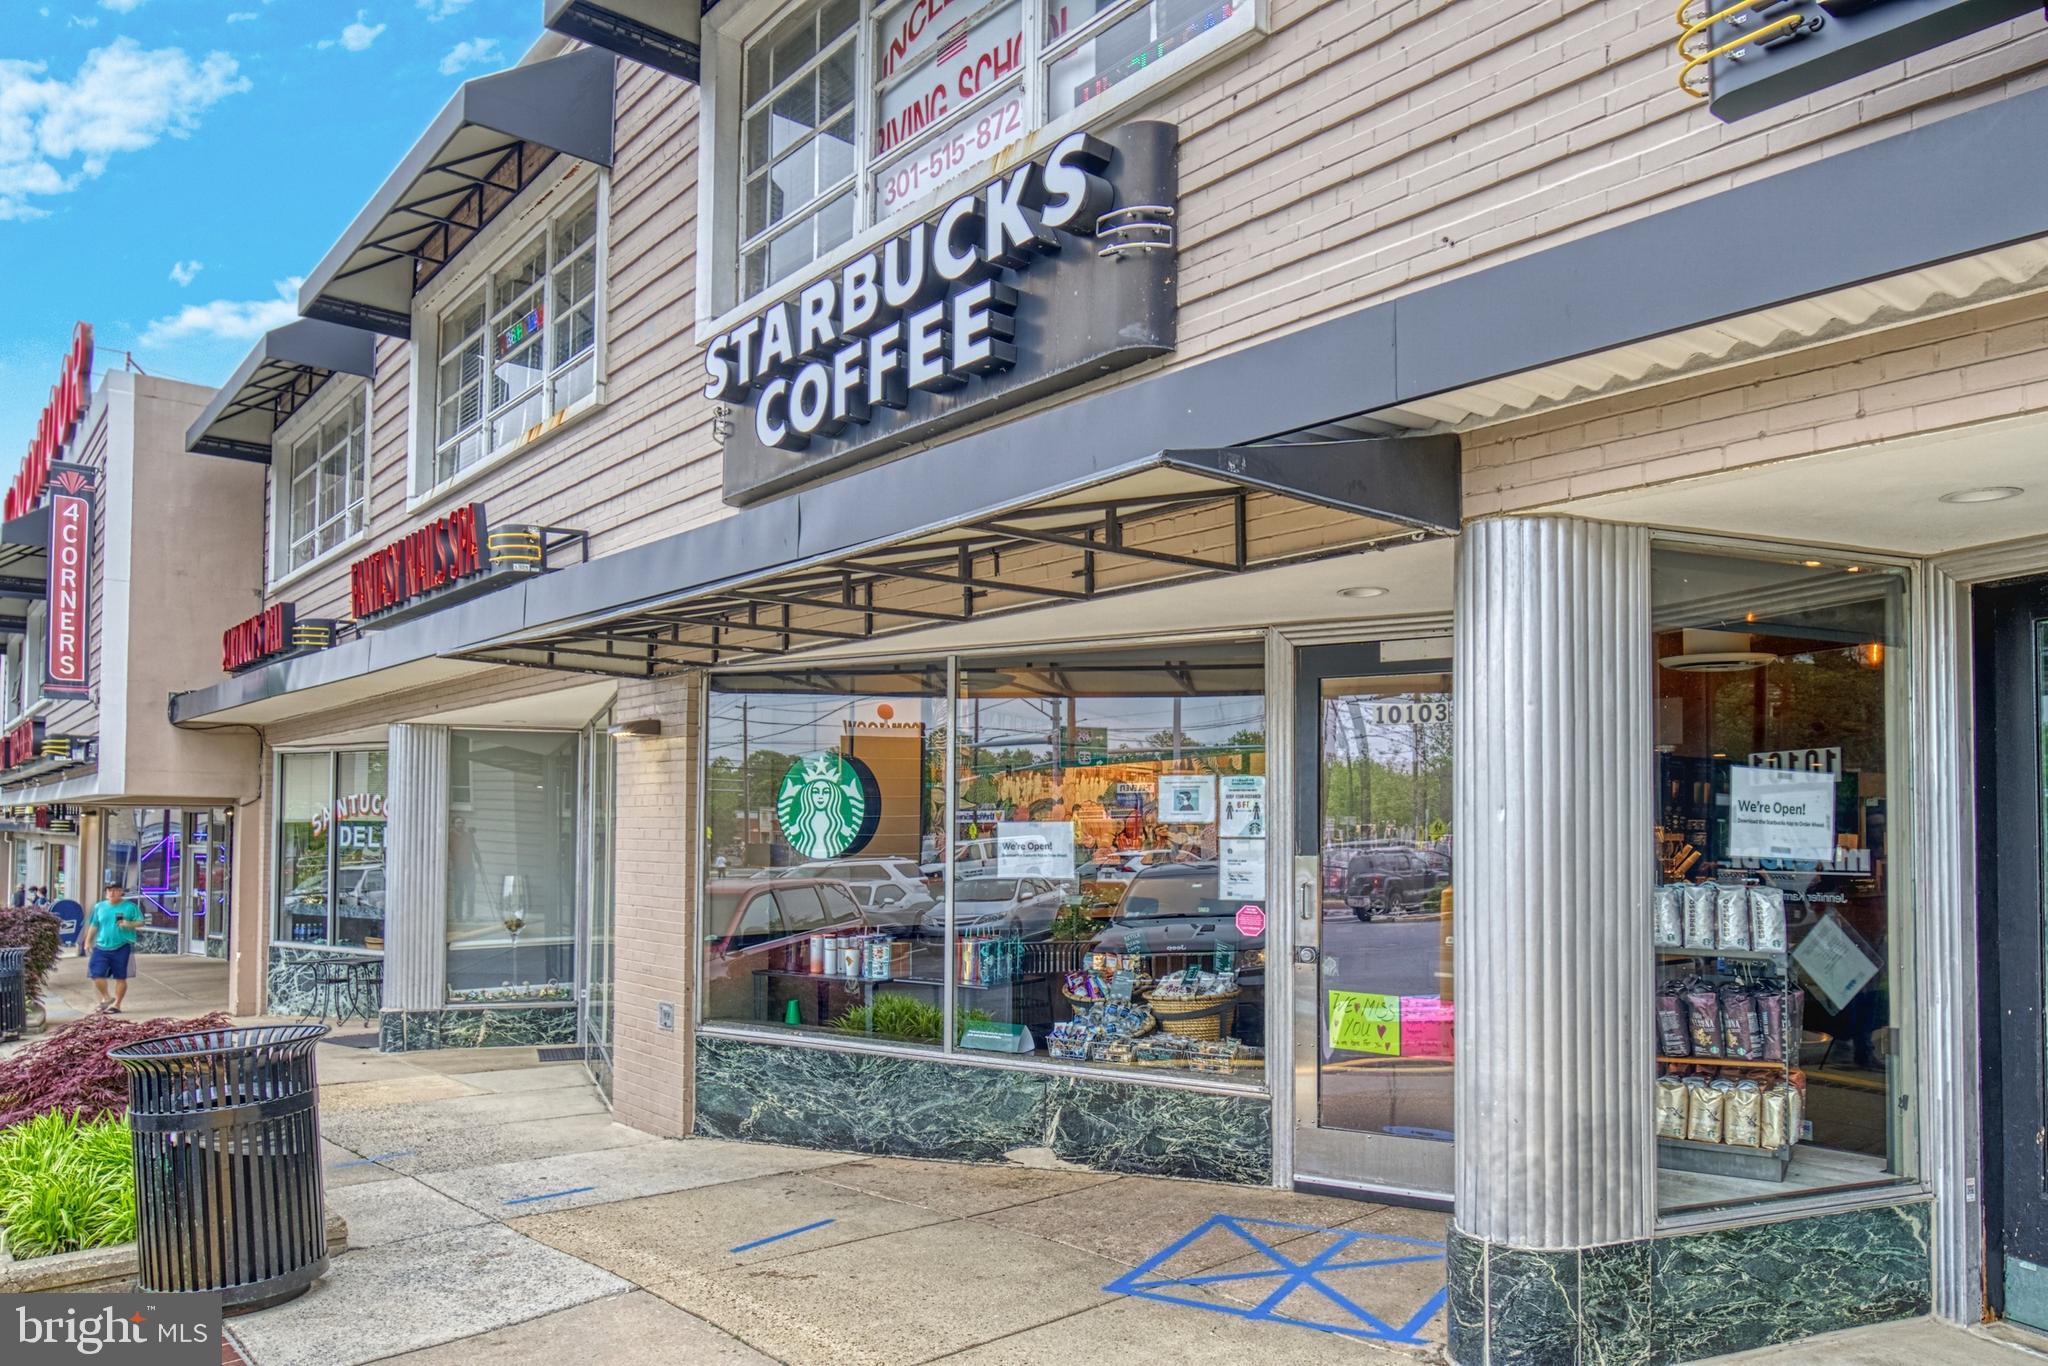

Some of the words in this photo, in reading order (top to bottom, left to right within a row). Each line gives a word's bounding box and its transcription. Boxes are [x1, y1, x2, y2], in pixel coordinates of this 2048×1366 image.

[884, 98, 1025, 206] 301-515-872
[703, 132, 1088, 400] STARBUCKS
[755, 278, 993, 448] COFFEE
[62, 503, 80, 522] 4
[405, 517, 450, 598] NAILS
[449, 502, 483, 579] SPA
[58, 525, 80, 675] CORNERS
[1376, 703, 1447, 724] 10103
[1738, 800, 1770, 813] We're
[1773, 802, 1806, 816] Open!
[1002, 842, 1026, 851] We're
[1027, 841, 1053, 852] Open!
[1688, 899, 1696, 937] ESPRESSO
[1333, 993, 1357, 1014] WE
[1344, 1018, 1371, 1036] YOU
